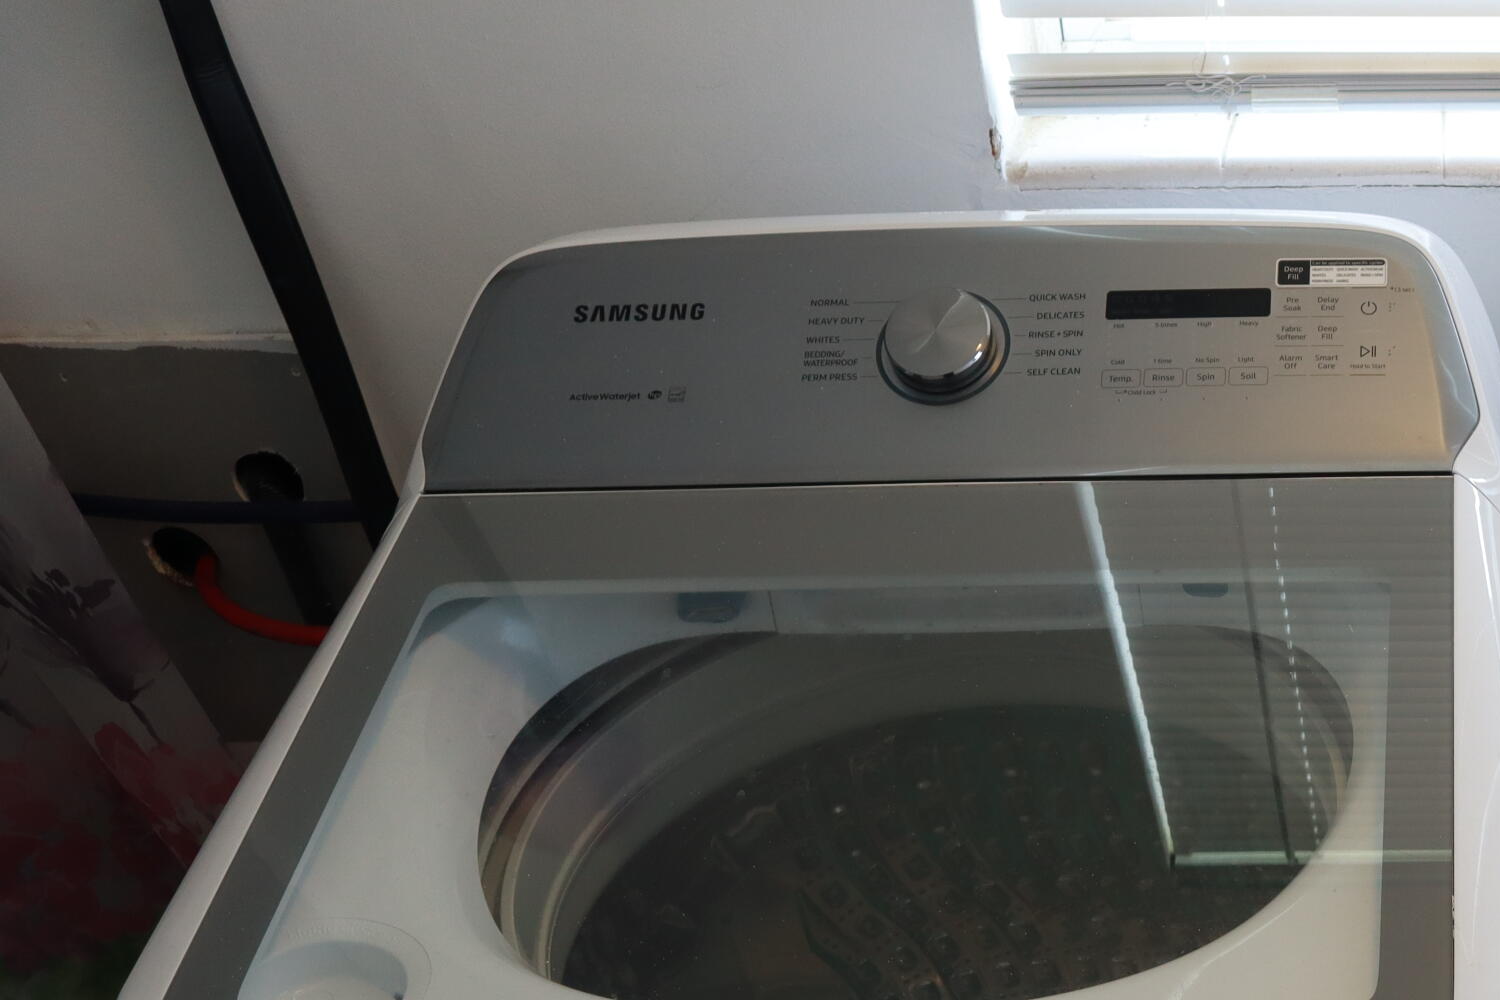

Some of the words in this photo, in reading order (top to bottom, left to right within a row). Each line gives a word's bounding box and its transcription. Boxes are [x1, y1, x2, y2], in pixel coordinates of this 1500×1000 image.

[1029, 294, 1057, 302] QUICK
[1059, 293, 1086, 301] WASH
[573, 302, 706, 323] SAMSUNG
[1037, 312, 1085, 320] DELICATES
[808, 317, 838, 325] HEAVY
[840, 317, 865, 325] DUTY
[806, 336, 840, 344] WHITES
[804, 350, 845, 358] BEDDING/
[1035, 349, 1056, 357] SPIN
[1058, 348, 1082, 357] ONLY
[803, 359, 858, 367] WATERPROOF
[1026, 368, 1048, 376] SELF
[1050, 367, 1081, 375] CLEAN
[801, 374, 827, 382] PERM
[829, 373, 858, 381] PRESS
[1196, 373, 1215, 382] Spin
[1240, 372, 1256, 380] Soil
